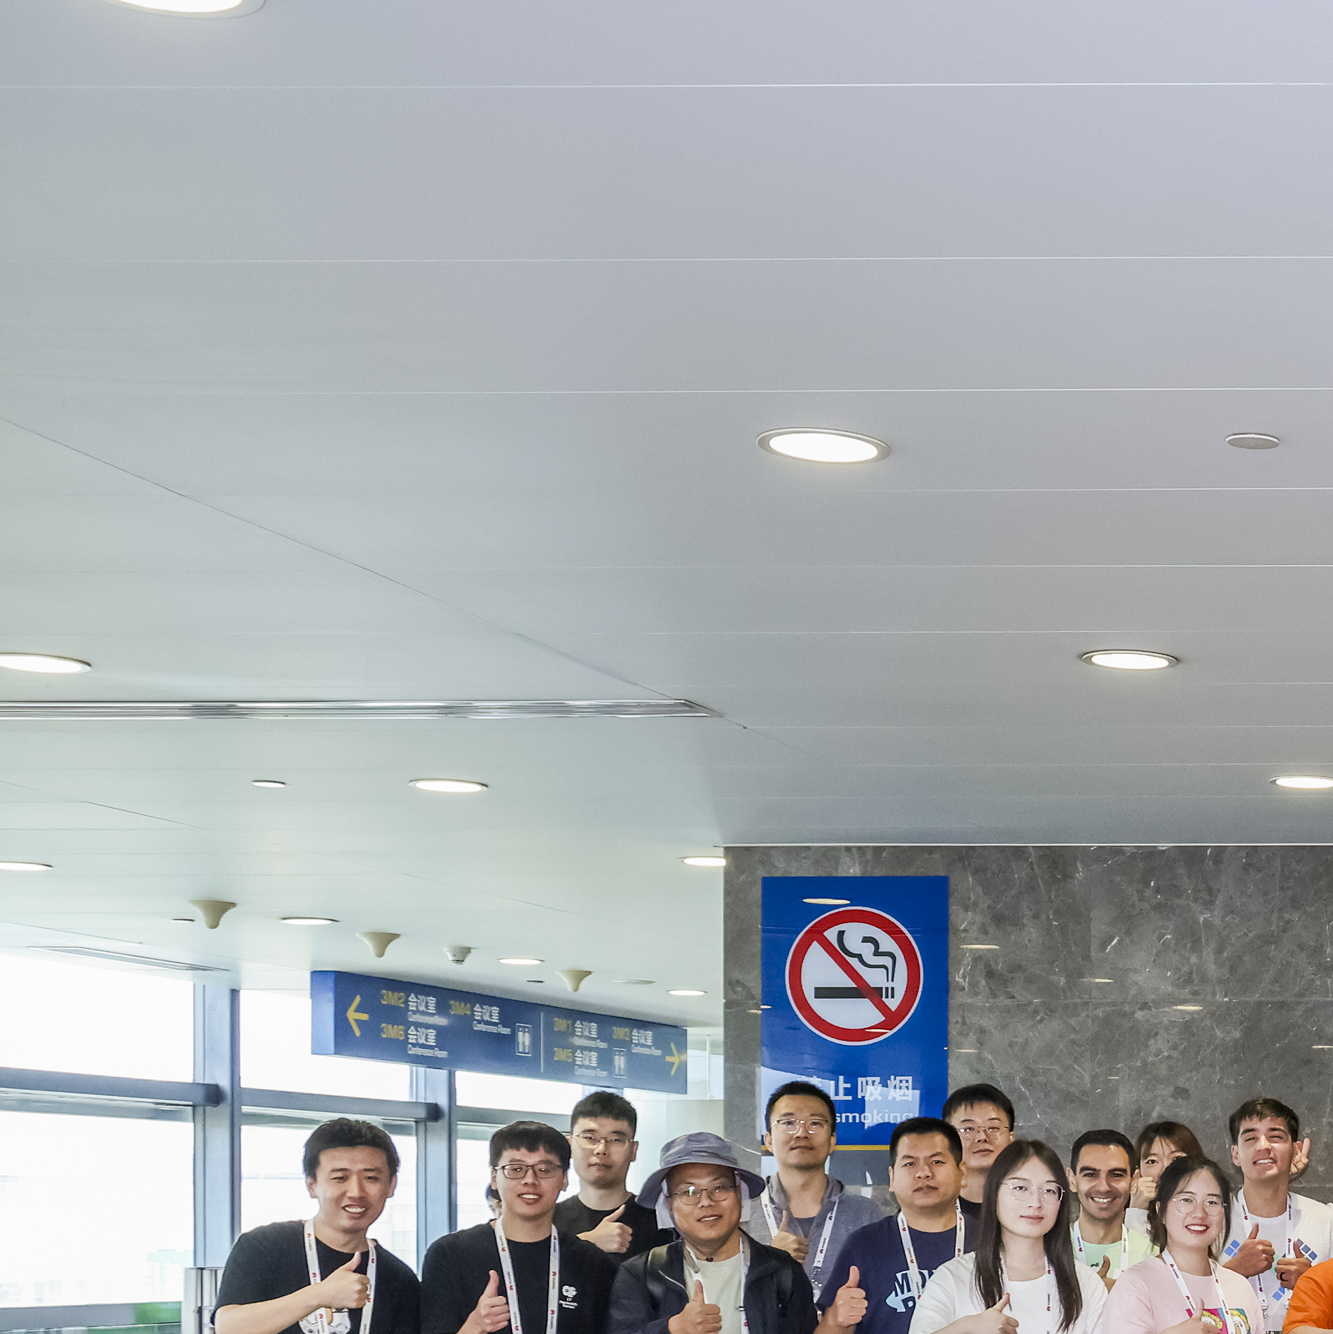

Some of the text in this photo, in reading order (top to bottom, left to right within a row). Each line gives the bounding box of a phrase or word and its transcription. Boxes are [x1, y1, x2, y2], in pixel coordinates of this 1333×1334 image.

[381, 990, 436, 1013] 3M2 会议室
[473, 1003, 500, 1022] 会议室
[408, 1026, 436, 1045] 会议室
[574, 1020, 598, 1038] 会议室
[632, 1028, 653, 1045] 会议室
[574, 1049, 598, 1067] 会议室
[812, 1075, 913, 1101] 止吸烟
